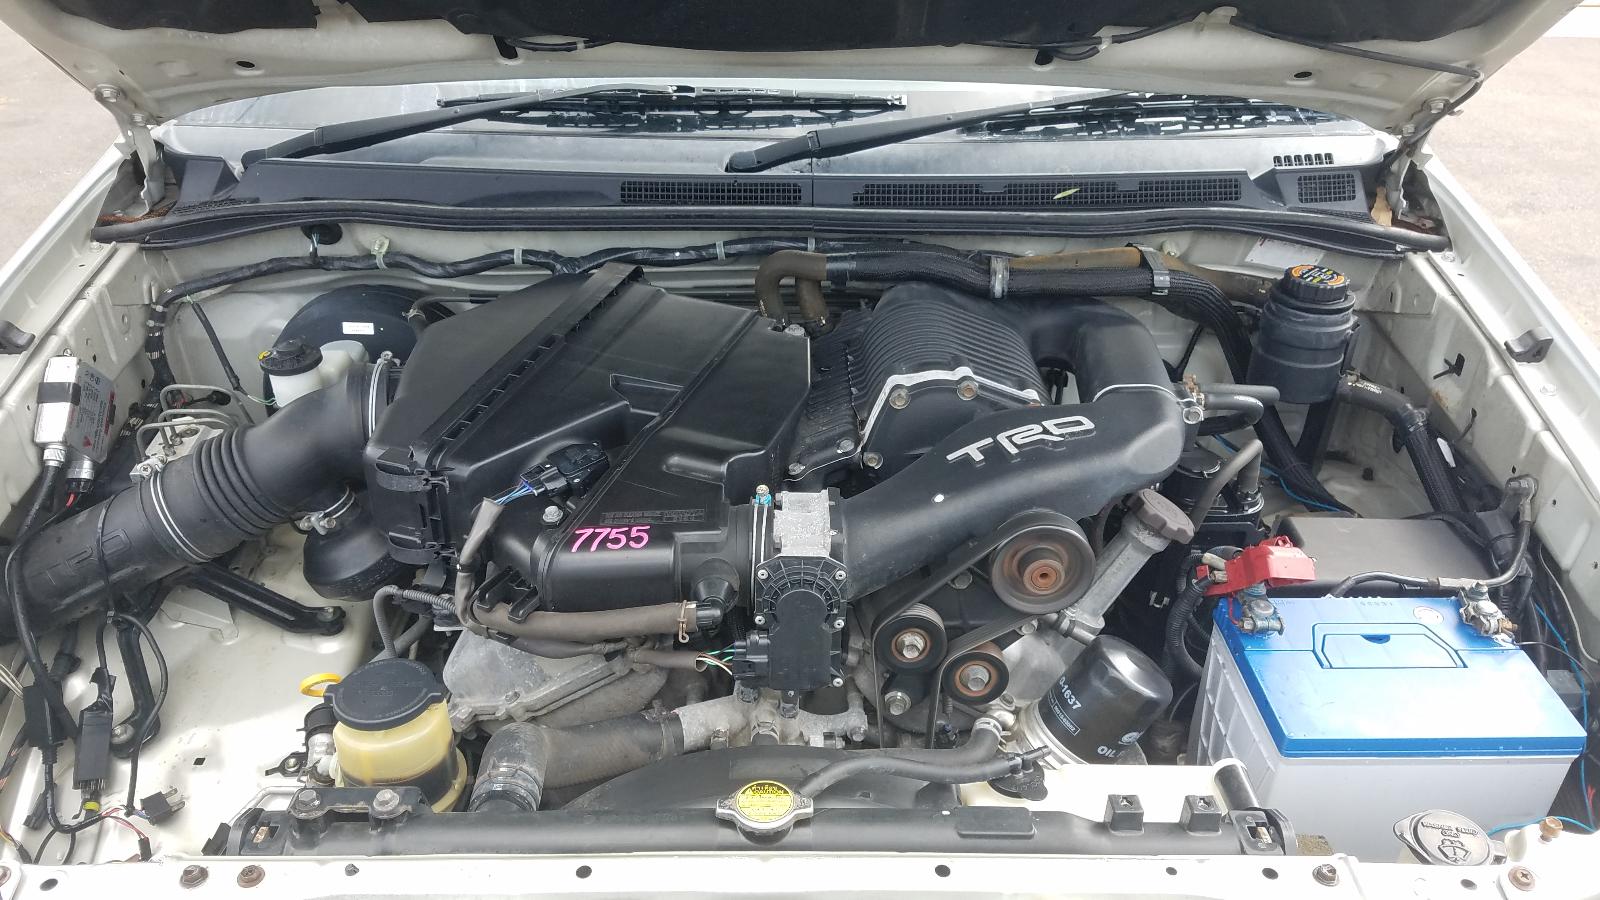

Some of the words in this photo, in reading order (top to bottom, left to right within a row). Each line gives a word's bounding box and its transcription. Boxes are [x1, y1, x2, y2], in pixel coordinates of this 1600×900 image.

[946, 415, 1095, 462] TRD
[571, 525, 651, 553] 7755
[1097, 745, 1117, 758] OIL
